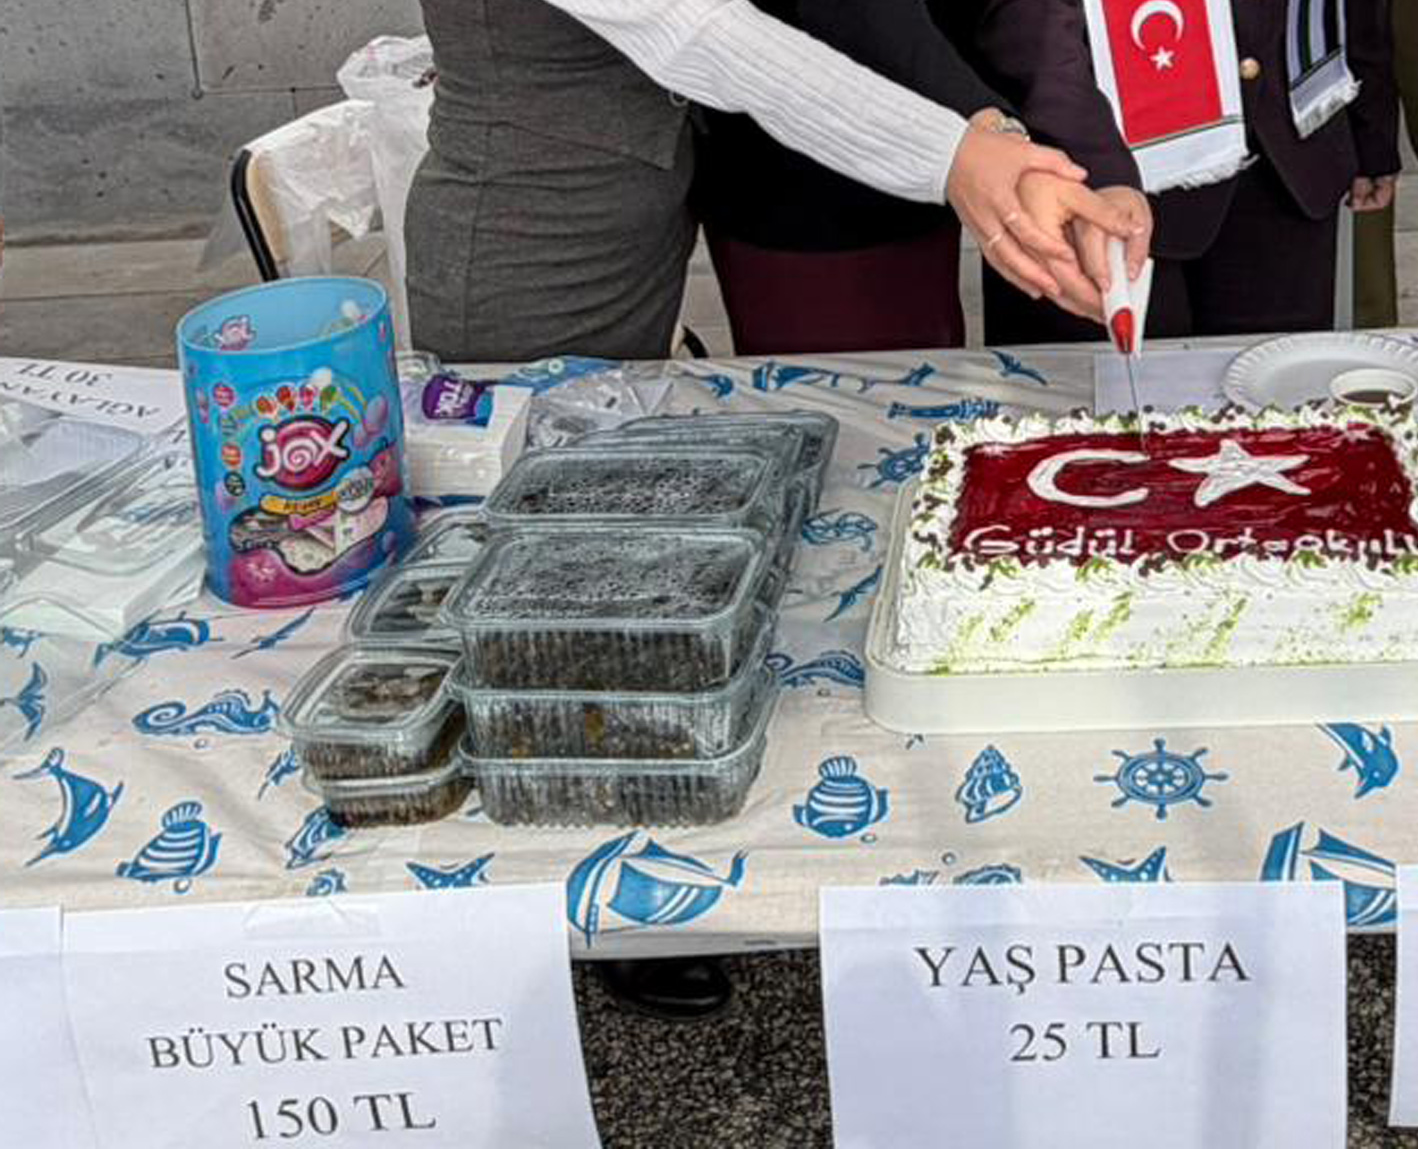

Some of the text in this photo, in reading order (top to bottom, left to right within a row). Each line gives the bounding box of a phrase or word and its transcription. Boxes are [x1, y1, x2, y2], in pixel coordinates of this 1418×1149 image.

[964, 525, 1135, 555] Güdül
[224, 954, 406, 999] SARMA
[914, 941, 1252, 996] YAŞ PASTA
[147, 1017, 503, 1069] BÜYÜK PAKET
[1009, 1021, 1161, 1063] 25 TL
[247, 1092, 437, 1141] 150 TL
